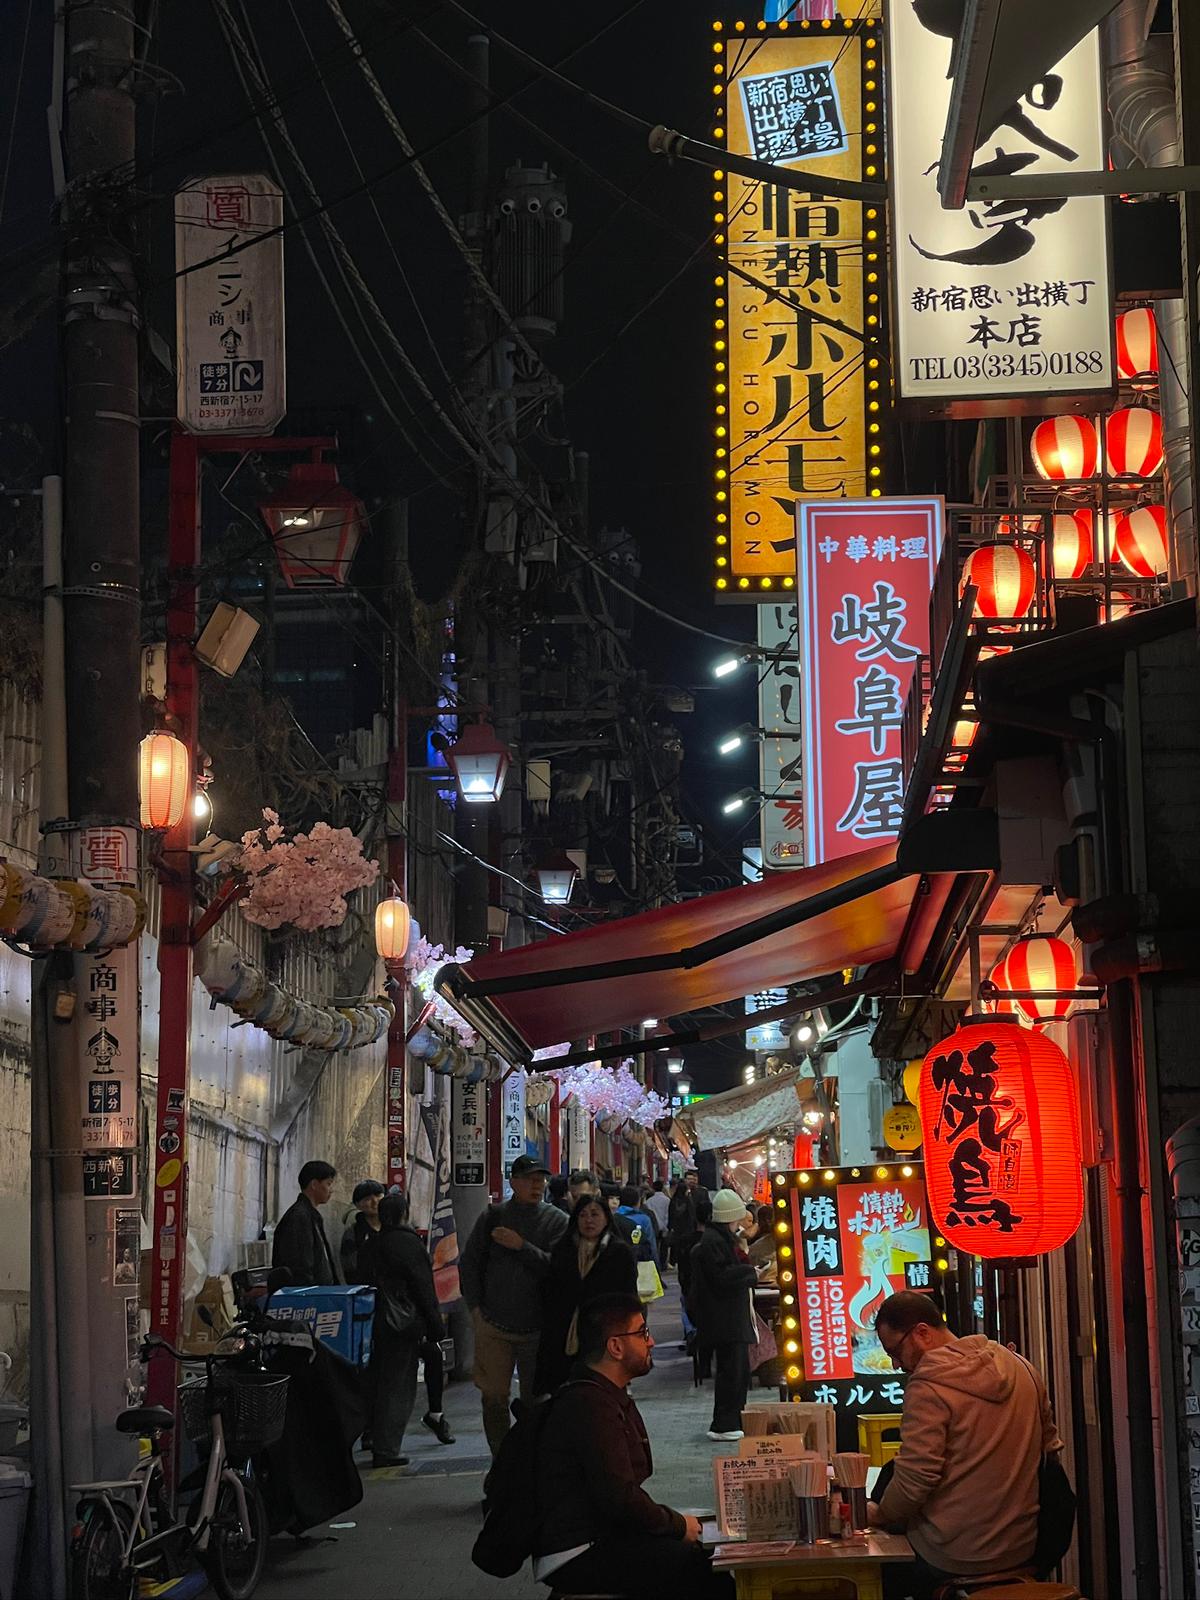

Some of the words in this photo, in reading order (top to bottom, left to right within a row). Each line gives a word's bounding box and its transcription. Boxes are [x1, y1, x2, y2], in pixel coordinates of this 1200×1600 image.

[747, 72, 830, 107] 新宿思い
[753, 95, 833, 133] 出横丁
[759, 122, 840, 159] 酒場
[213, 192, 244, 223] 質
[910, 280, 1096, 312] 新宿思い出横丁
[966, 313, 1043, 349] 本店
[202, 364, 227, 377] 徒歩
[203, 380, 228, 392] 7分
[743, 374, 762, 554] HORUMON
[818, 535, 930, 563] 中華料理
[831, 580, 922, 840] 岐阜屋
[87, 835, 123, 872] 質
[91, 1084, 119, 1097] 徒歩
[461, 1081, 477, 1126] 安兵衛
[932, 1040, 1025, 1232] 焼鳥
[83, 1158, 124, 1174] 西新宿
[90, 1175, 120, 1190] 1-2
[858, 1188, 905, 1215] 情熱
[801, 1195, 839, 1271] 焼肉
[847, 1206, 921, 1236] ホルモン
[907, 1263, 929, 1287] 情
[806, 1280, 827, 1375] HORUMON
[829, 1279, 848, 1358] JONETSU
[814, 1381, 905, 1406] ホルモ
[723, 1459, 757, 1469] お飲み物
